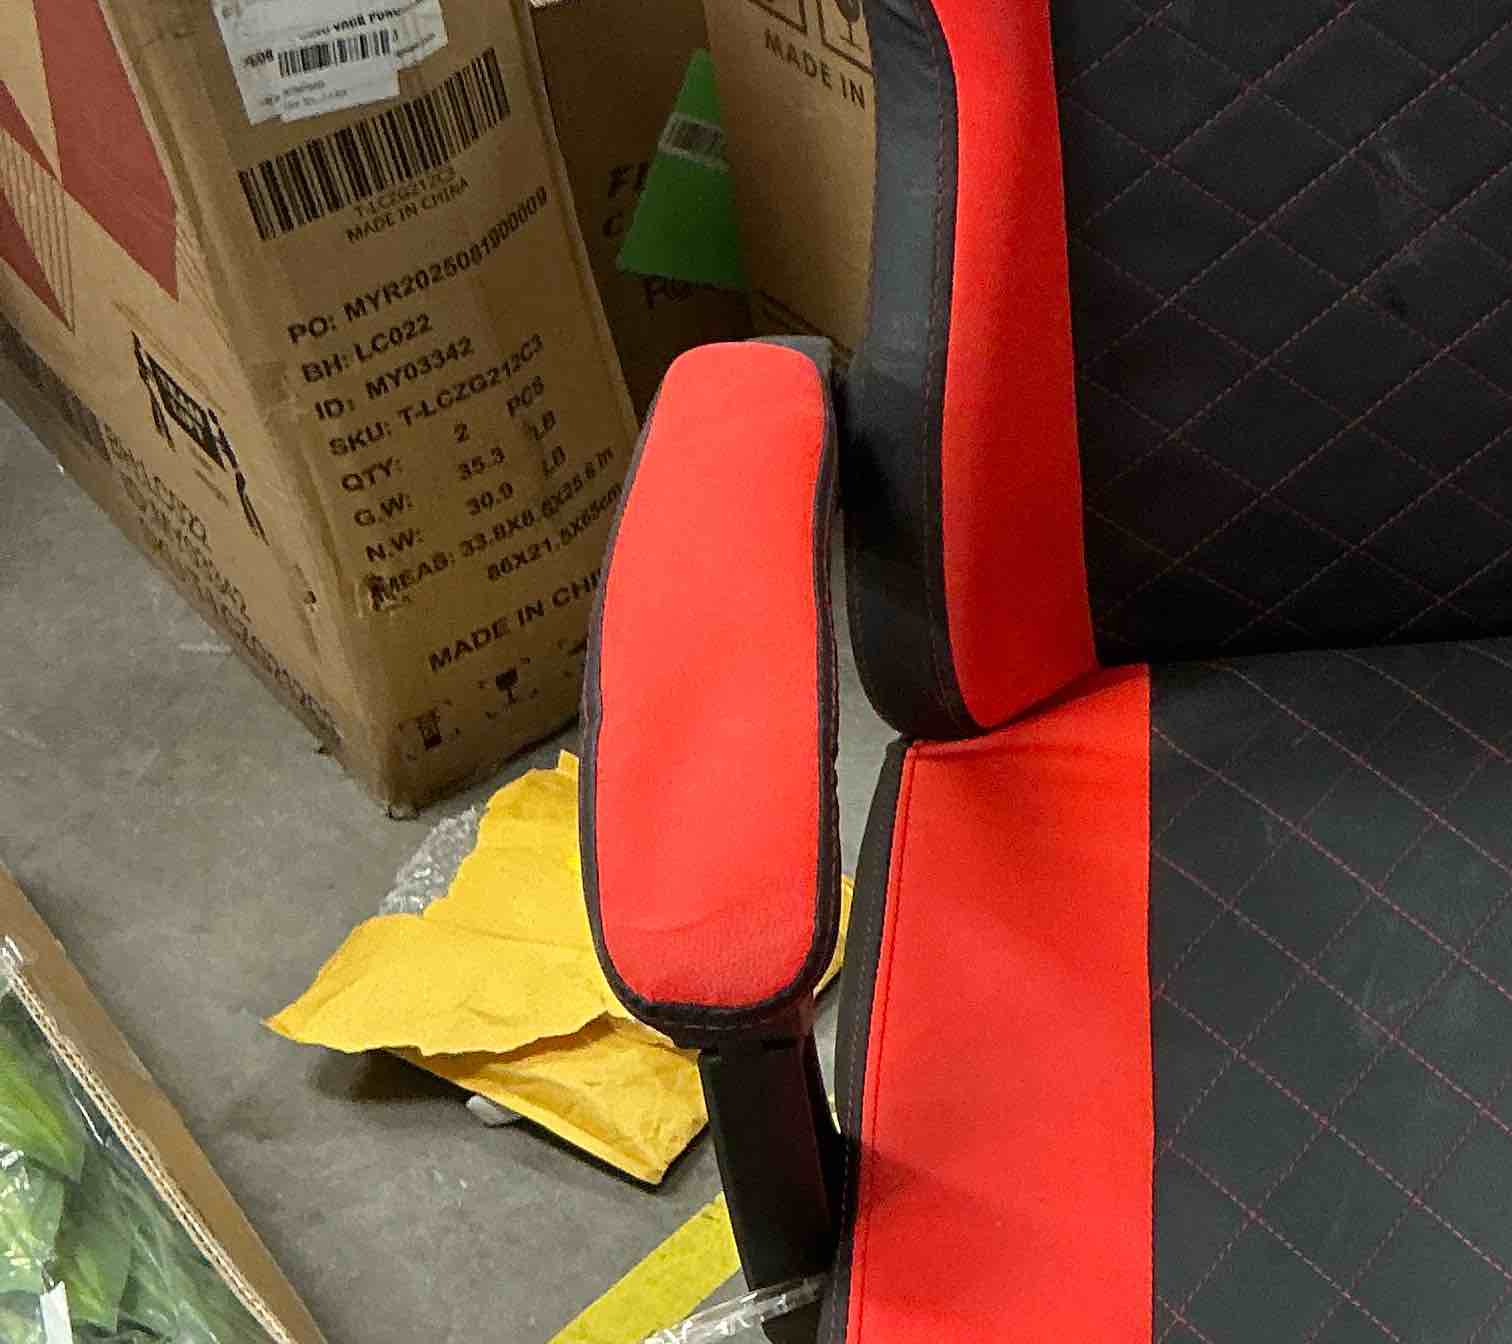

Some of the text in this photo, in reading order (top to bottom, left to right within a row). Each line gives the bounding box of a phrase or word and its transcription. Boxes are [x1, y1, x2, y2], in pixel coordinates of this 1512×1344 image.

[764, 28, 833, 91] MADE
[421, 176, 471, 210] CHINA
[287, 314, 337, 345] PO:
[353, 312, 434, 364] LC022
[365, 335, 476, 402] MY03342
[329, 420, 393, 457] SKU:
[341, 456, 404, 494] QTY:
[365, 527, 425, 563] N.W:
[428, 617, 512, 673] MADE
[516, 599, 546, 628] IN
